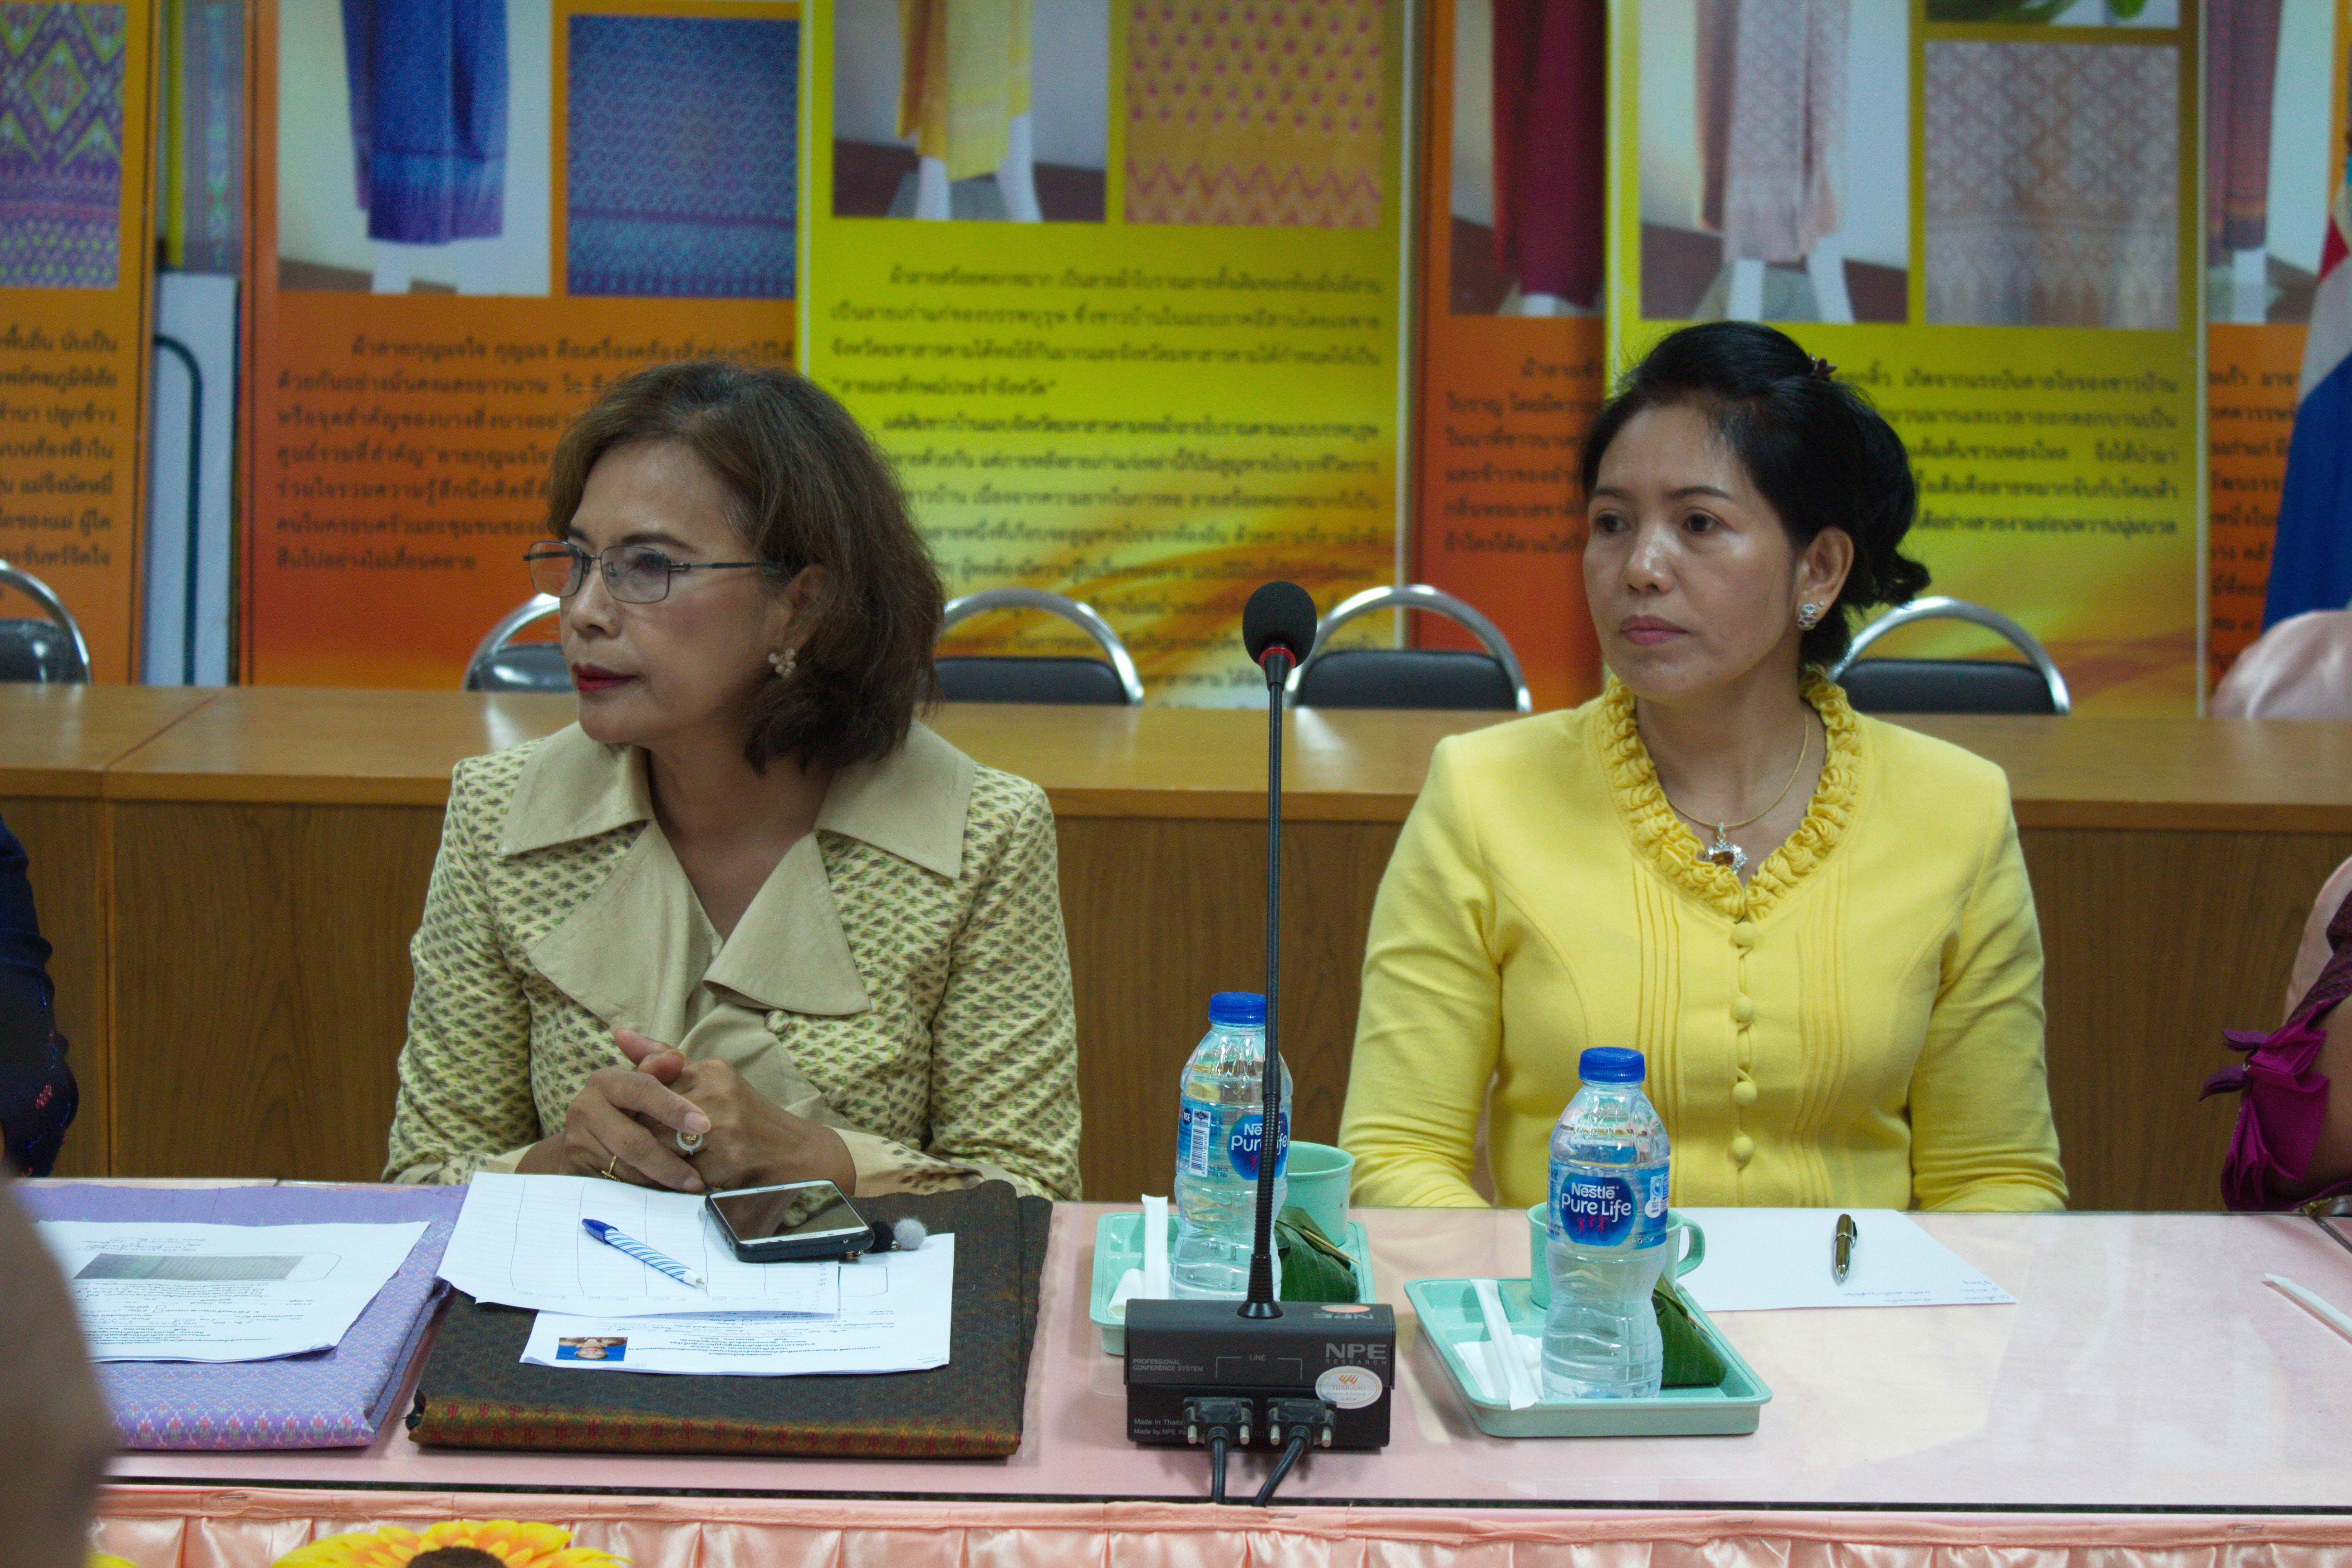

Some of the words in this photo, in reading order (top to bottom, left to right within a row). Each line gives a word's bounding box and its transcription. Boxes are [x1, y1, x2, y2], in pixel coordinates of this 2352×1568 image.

[1231, 1135, 1261, 1152] Pur
[1276, 1133, 1287, 1156] ife
[1561, 1193, 1598, 1215] Pure
[1602, 1200, 1632, 1223] Life
[1325, 1343, 1387, 1359] NPE
